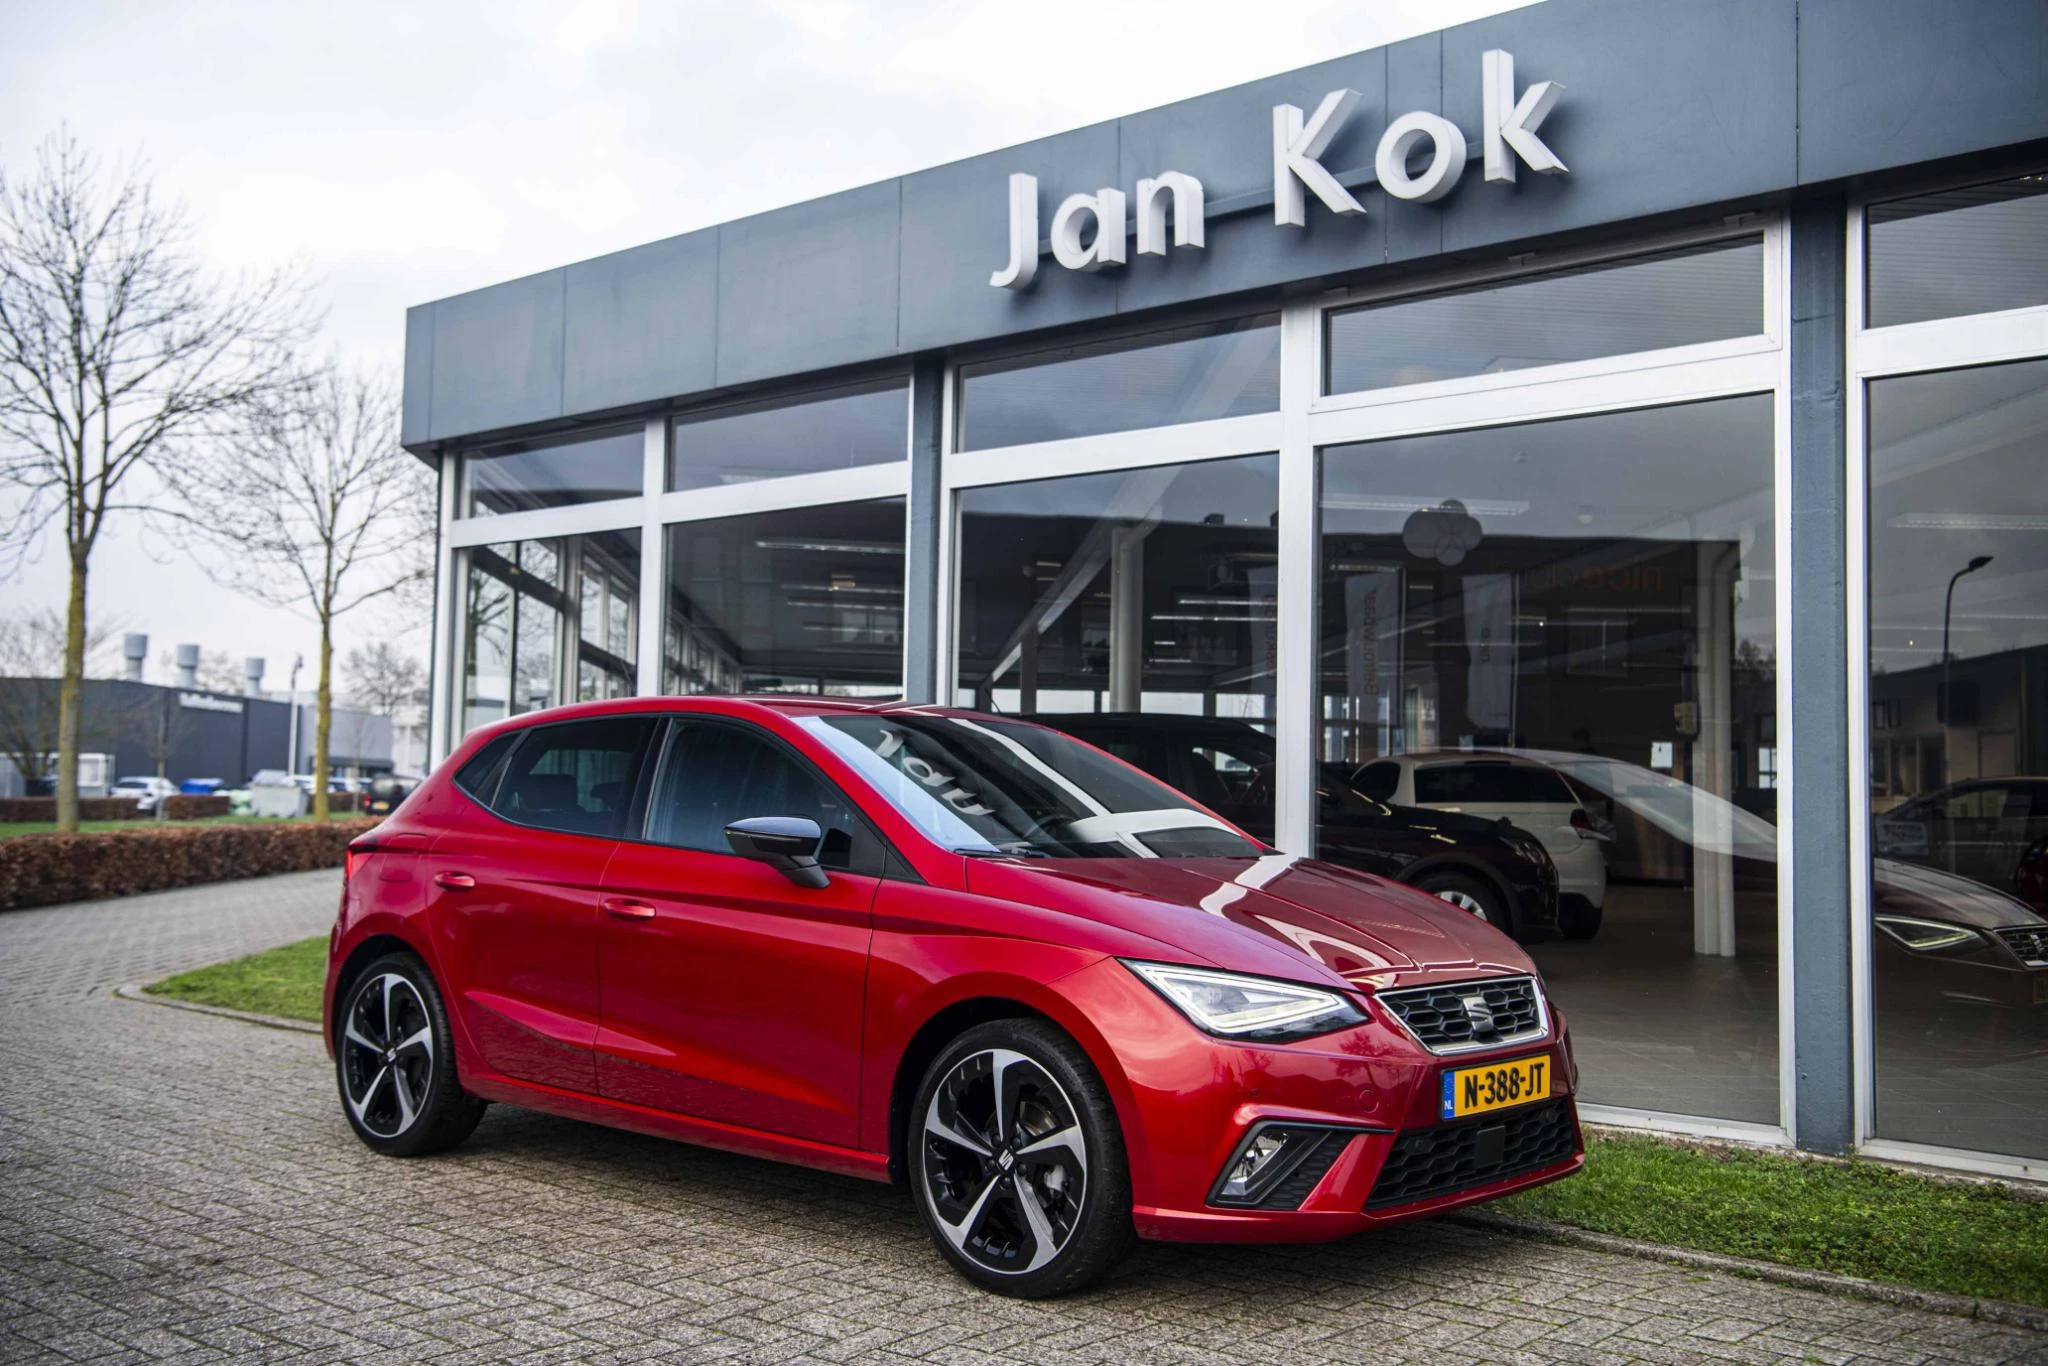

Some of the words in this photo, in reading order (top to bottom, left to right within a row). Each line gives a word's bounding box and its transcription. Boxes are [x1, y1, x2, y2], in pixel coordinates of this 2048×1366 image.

[990, 170, 1205, 290] Jan
[1272, 48, 1569, 227] Kok
[1444, 1099, 1454, 1111] NL
[1464, 1062, 1545, 1109] N-388-JT
